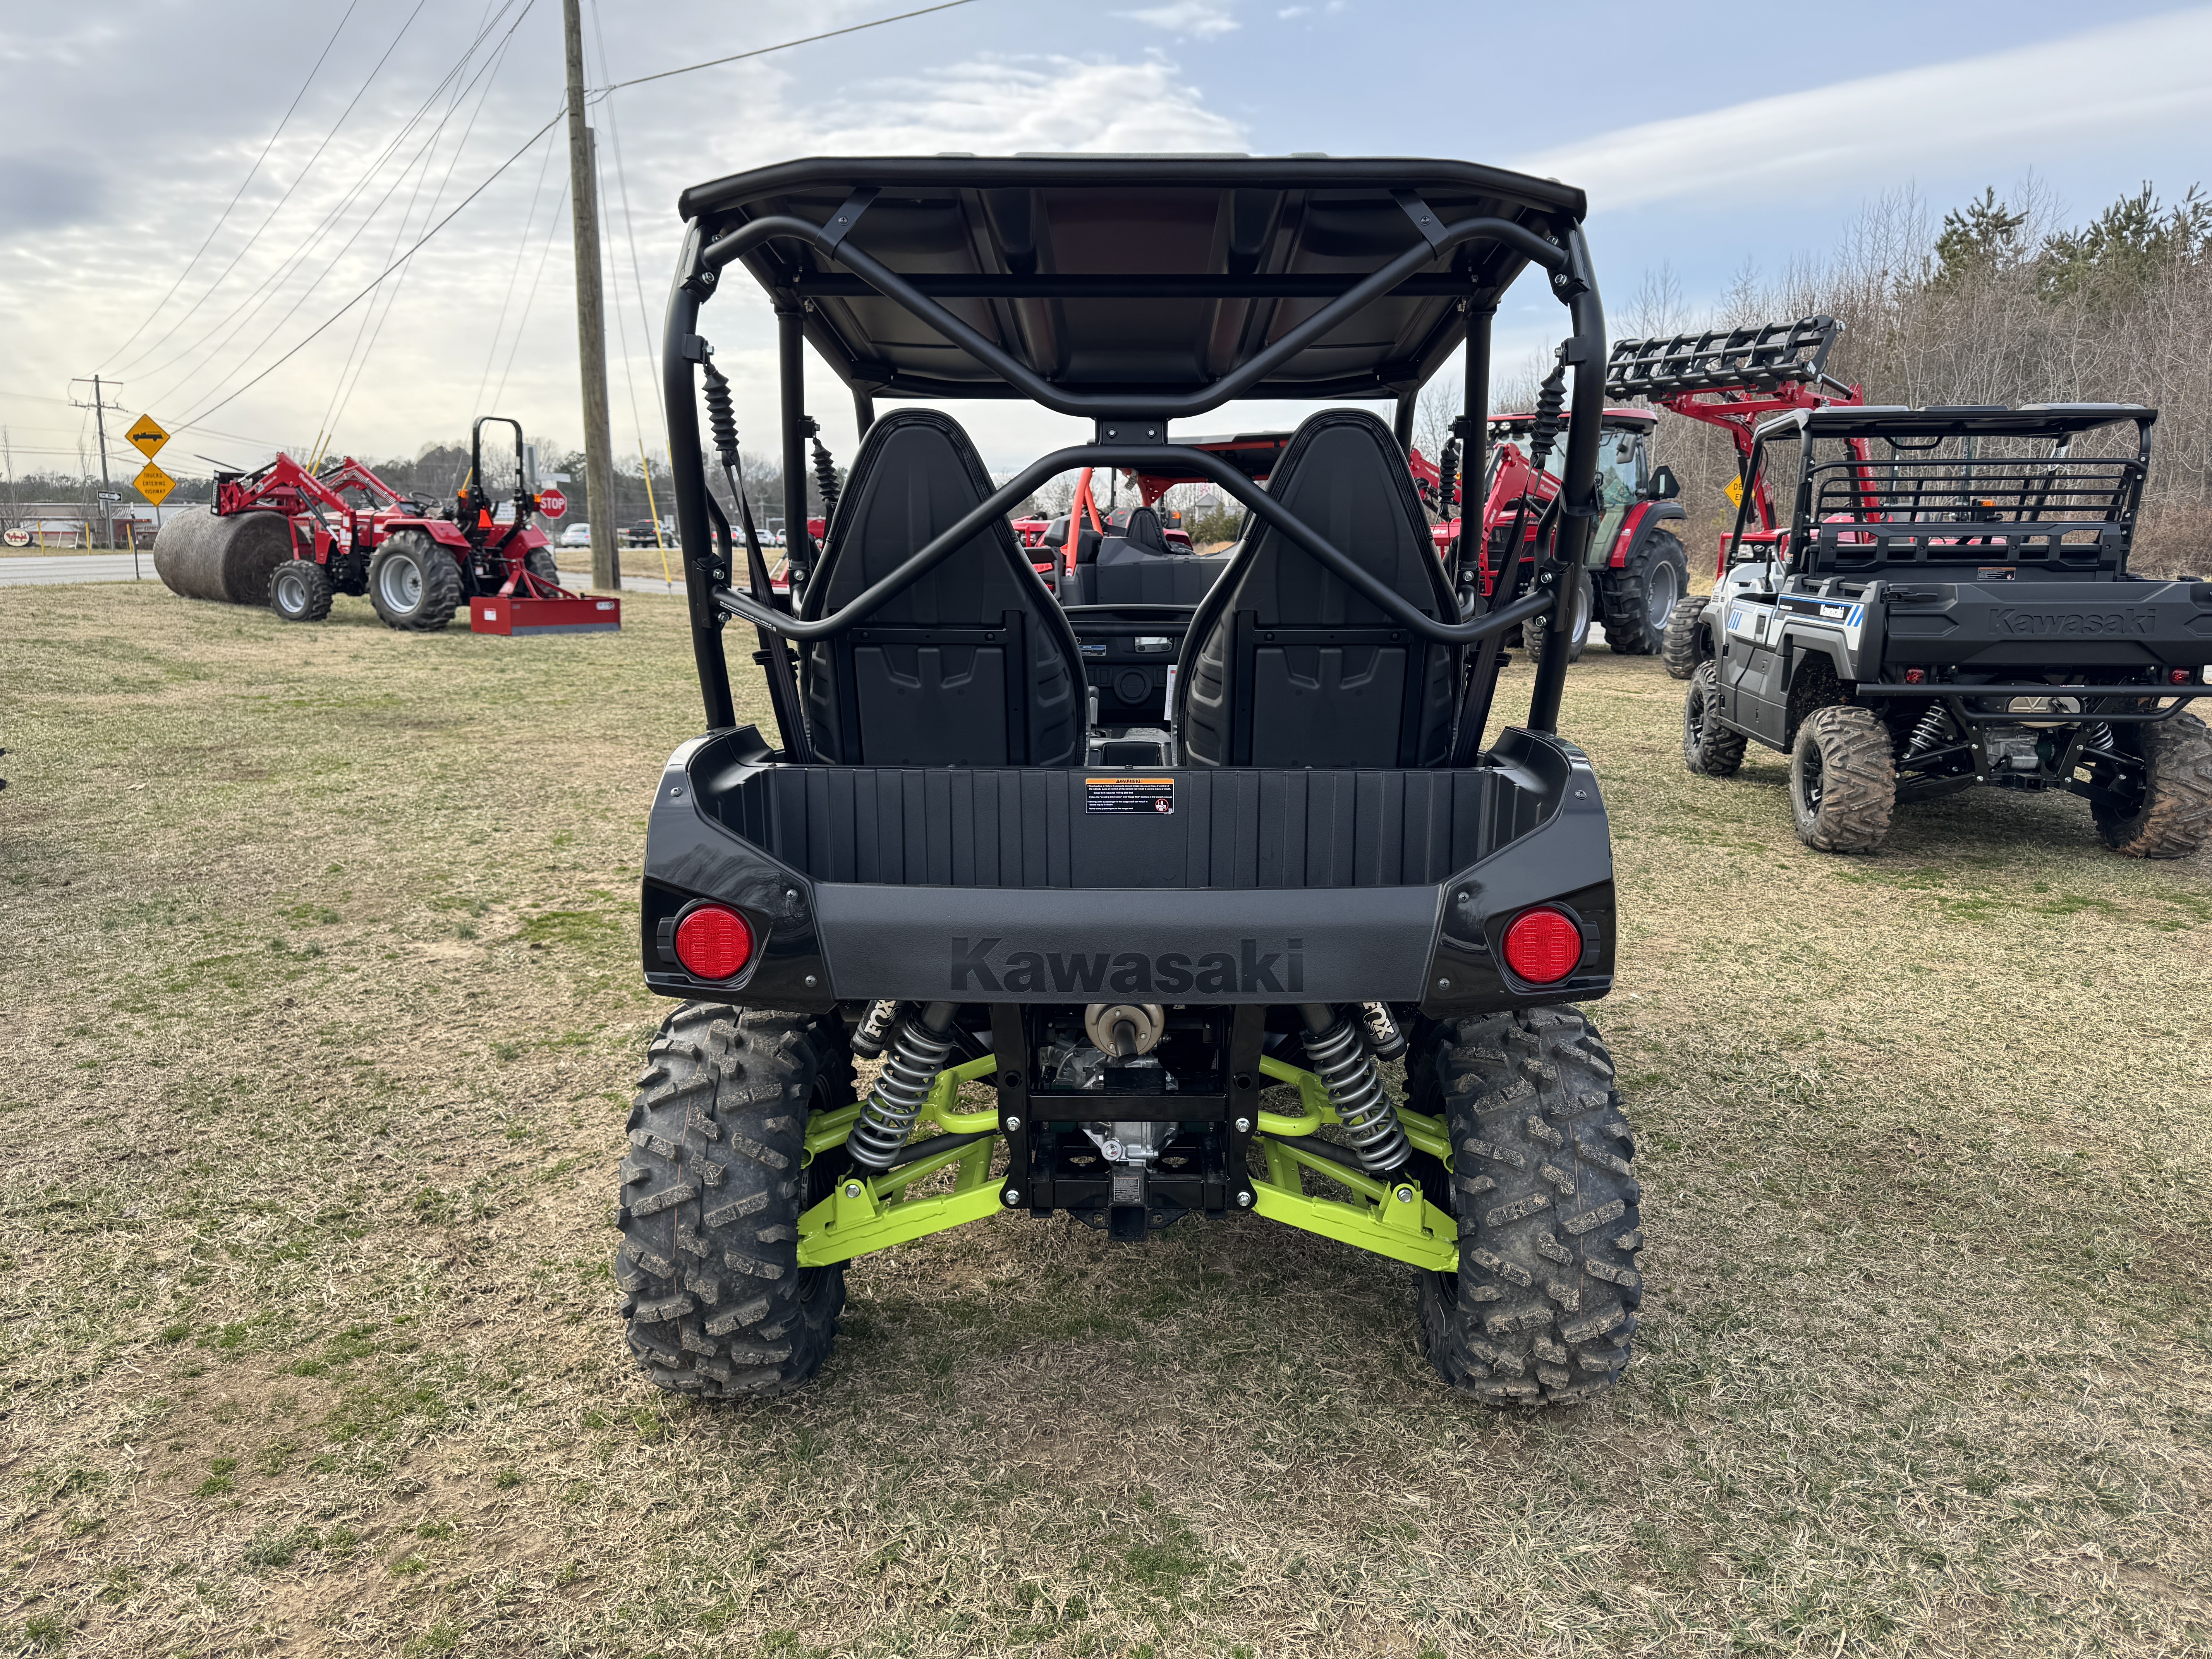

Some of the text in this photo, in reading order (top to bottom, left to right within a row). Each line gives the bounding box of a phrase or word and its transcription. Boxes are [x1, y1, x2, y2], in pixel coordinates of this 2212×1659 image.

[299, 472, 322, 495] Mahindra
[540, 497, 565, 510] STOP
[1820, 604, 1844, 618] Kawasaki
[1988, 608, 2157, 635] Kawasaki
[950, 937, 1304, 993] Kawasaki
[864, 1000, 898, 1038] FOX
